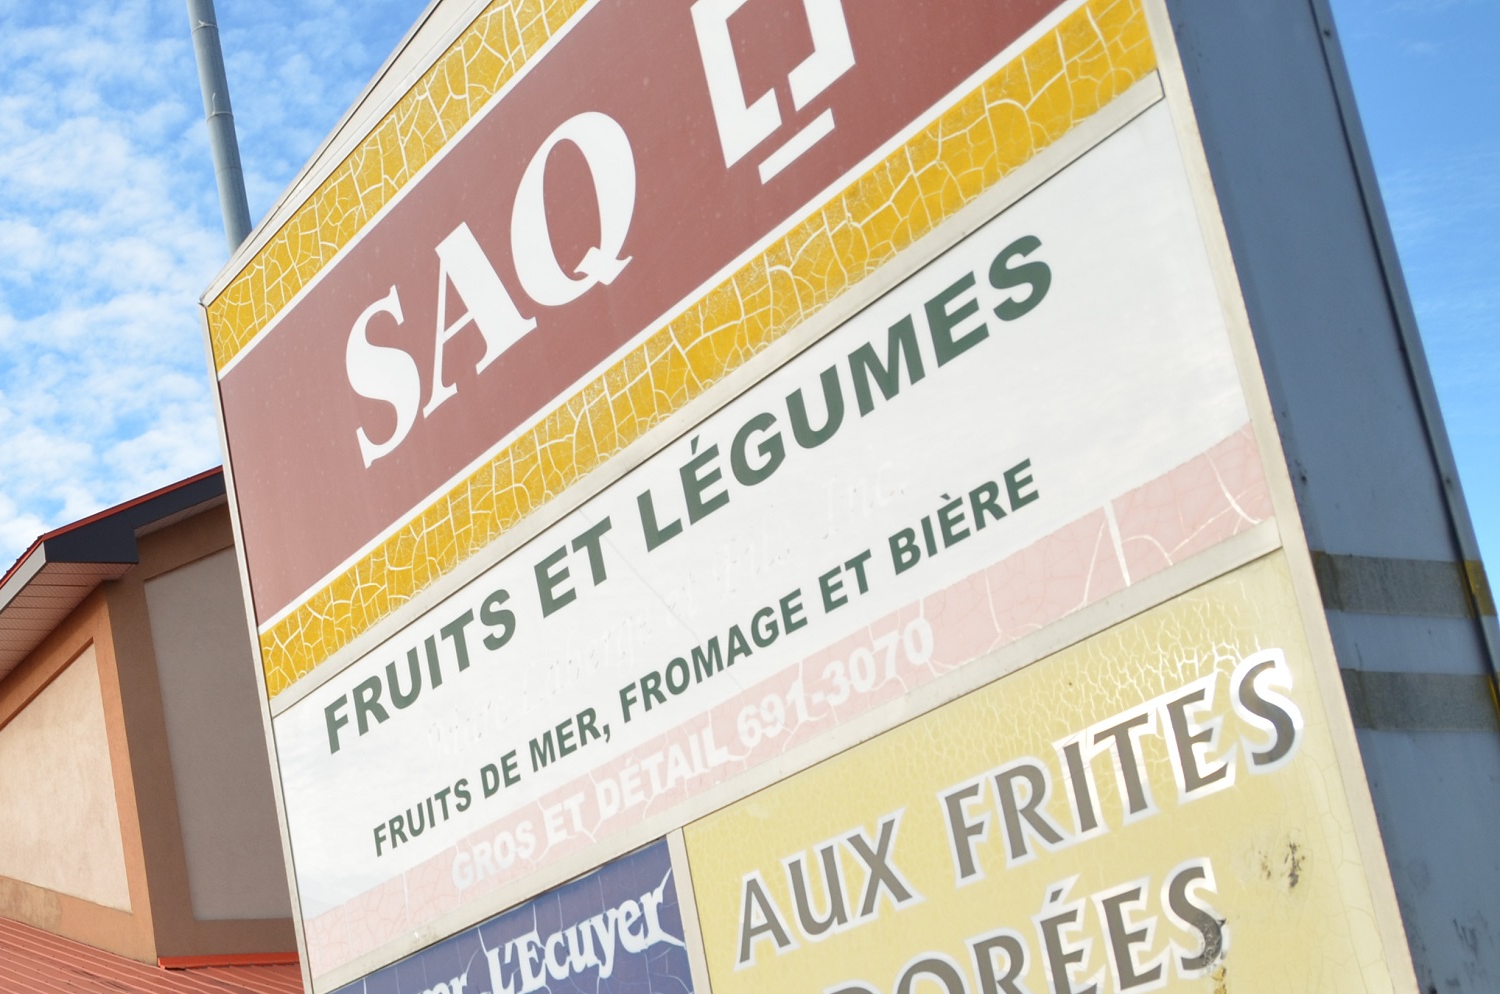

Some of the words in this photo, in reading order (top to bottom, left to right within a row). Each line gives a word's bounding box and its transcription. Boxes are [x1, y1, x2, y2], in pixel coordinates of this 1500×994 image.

[345, 111, 636, 469] SAQ
[324, 588, 516, 755] FRUITS
[534, 516, 612, 618] ET
[637, 235, 1052, 552] LÉGUMES
[373, 778, 471, 857] FRUITS
[480, 749, 521, 799] DE
[529, 707, 611, 773] MER,
[619, 588, 808, 723] FROMAGE
[818, 549, 871, 613] ET
[888, 458, 1040, 576] BIÈRE
[451, 822, 536, 890] GROS
[543, 798, 588, 844] ET
[598, 721, 733, 820] DÉTAIL
[735, 617, 934, 748] 691-3070
[736, 812, 918, 967] AUX
[940, 654, 1299, 884] FRITES
